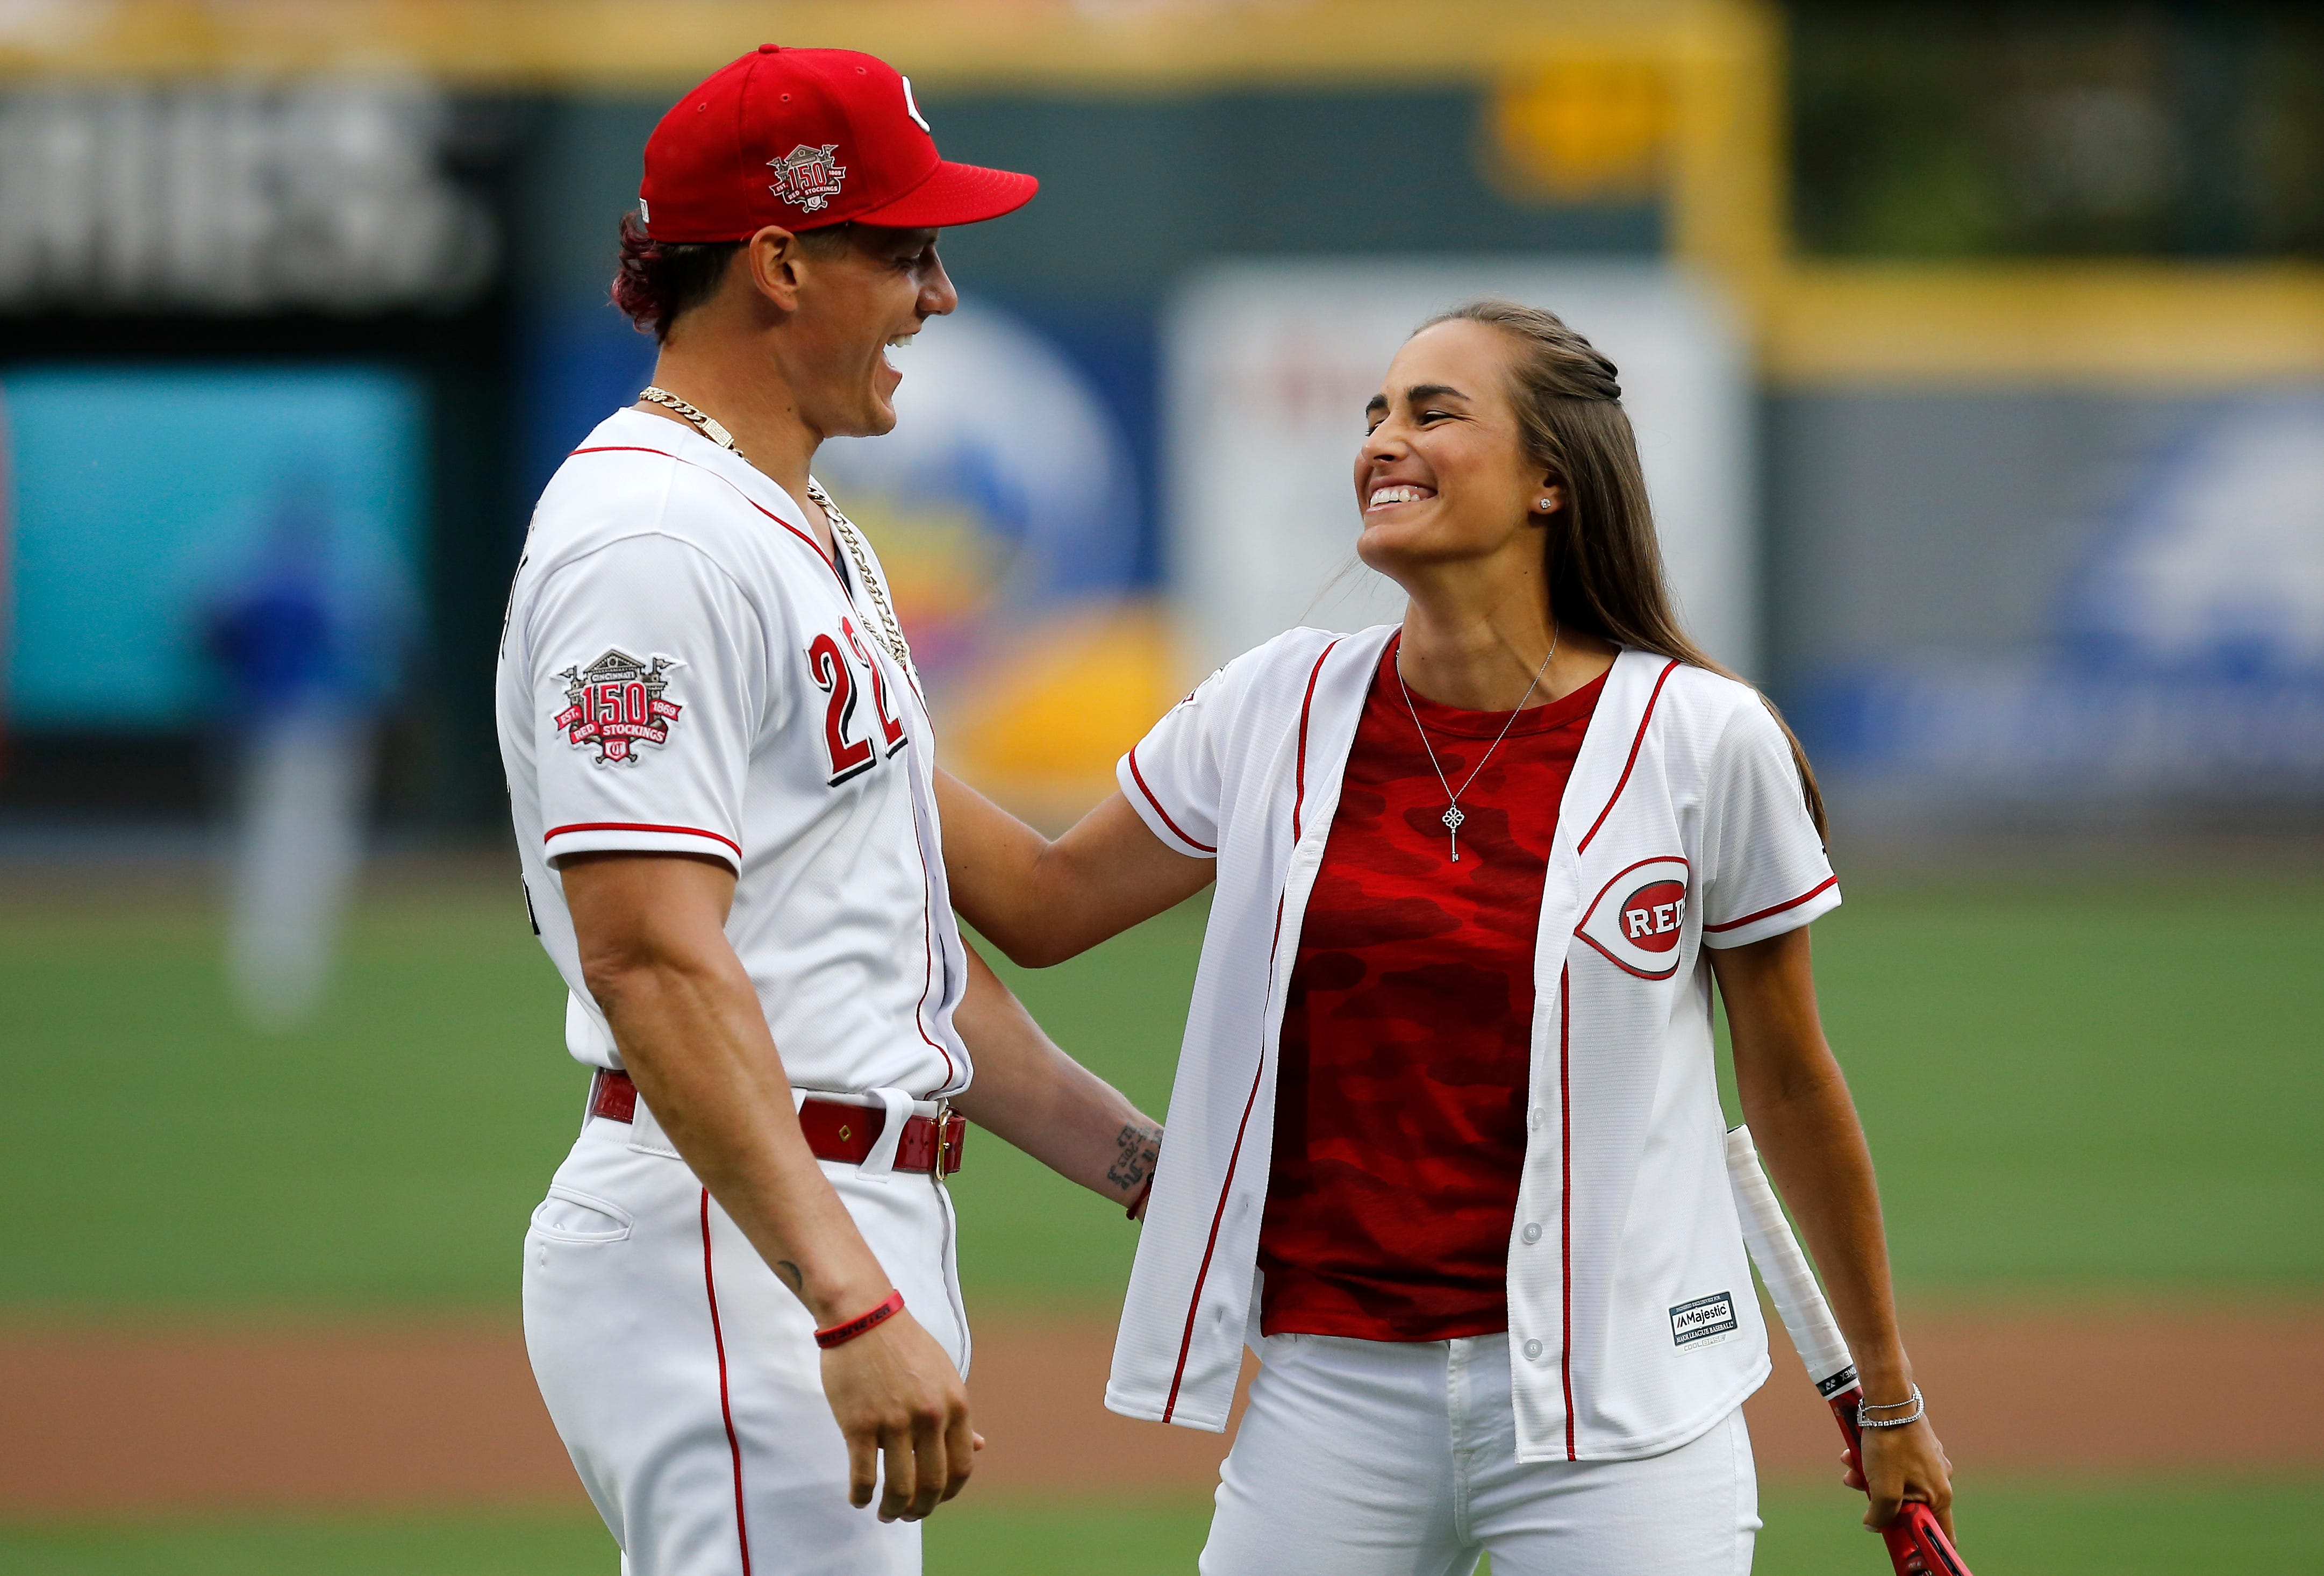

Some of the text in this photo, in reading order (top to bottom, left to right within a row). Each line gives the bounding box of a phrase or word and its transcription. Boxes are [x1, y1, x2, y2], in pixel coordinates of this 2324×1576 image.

[788, 161, 827, 191] 150
[788, 186, 838, 200] RED STOCKINGS
[592, 671, 634, 681] CINCINNATI
[581, 681, 647, 725] 150
[652, 701, 677, 716] 1869
[804, 616, 909, 788] 22
[560, 709, 579, 724] EST.
[574, 724, 665, 743] RED STOCKINGS
[1625, 898, 1686, 939] RED
[1686, 1305, 1727, 1324] Majestic
[1676, 1335, 1689, 1343] MAJOR
[1689, 1329, 1710, 1339] LEAGUE
[1840, 1367, 1857, 1381] ONEX
